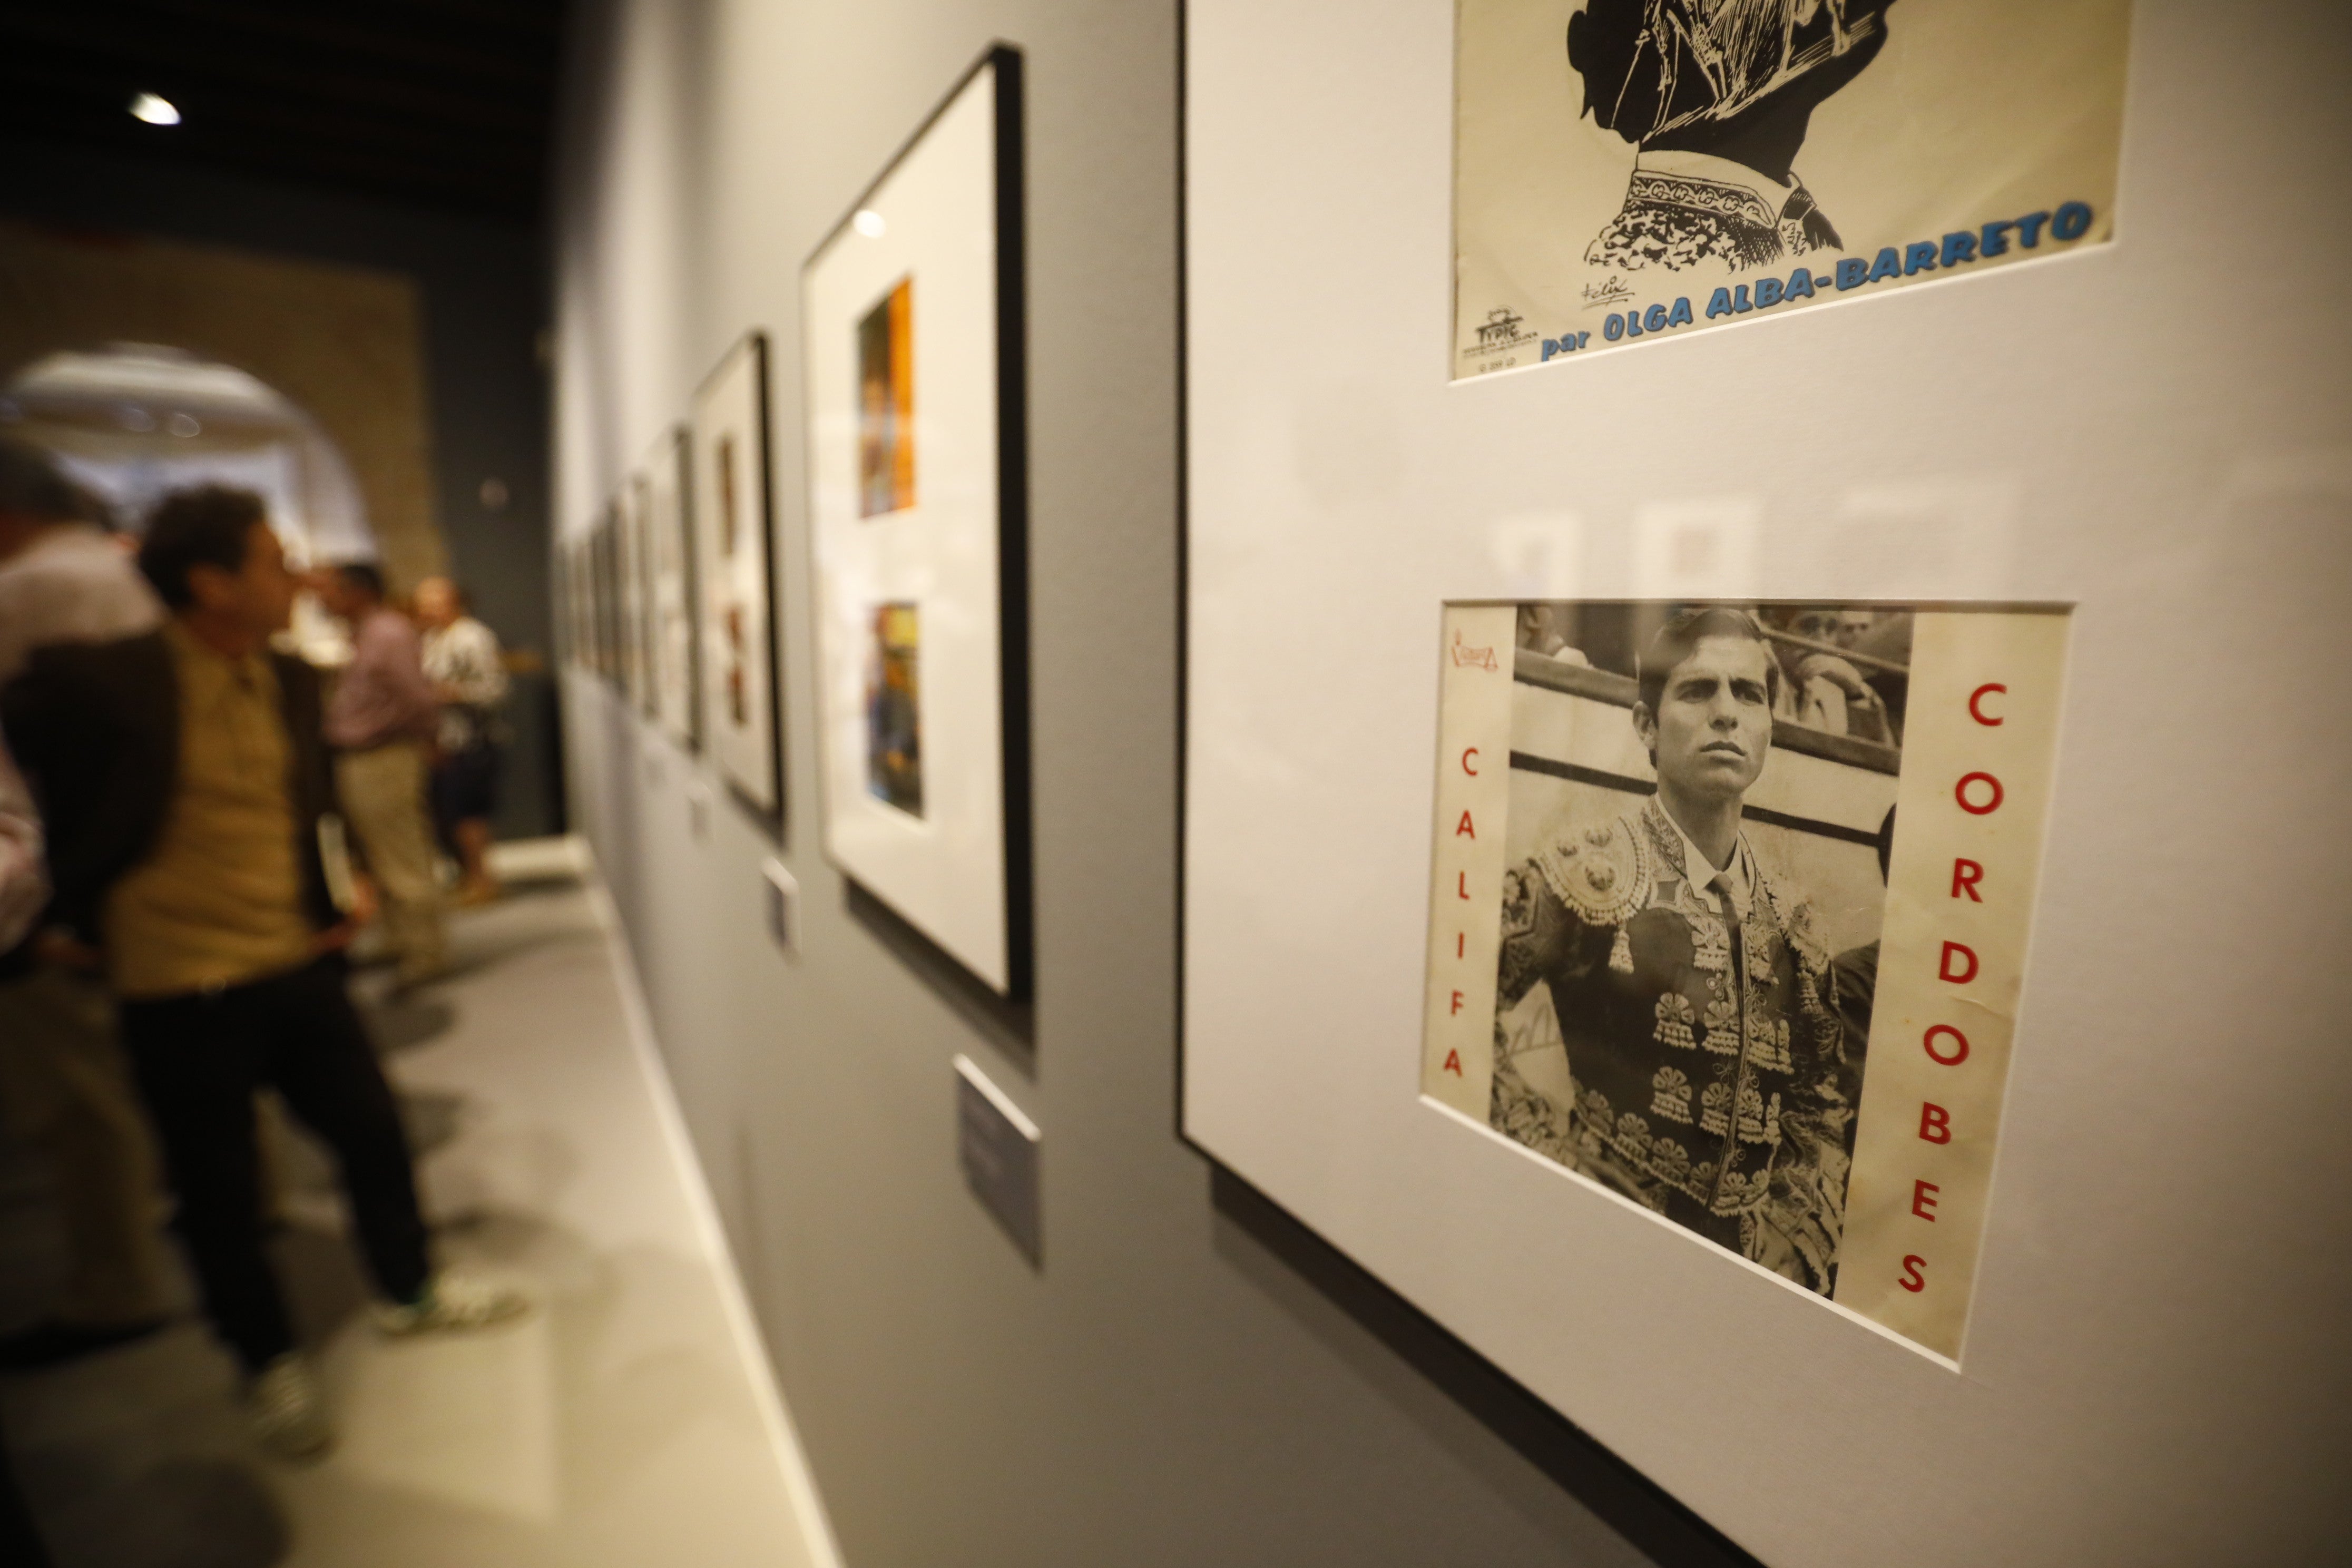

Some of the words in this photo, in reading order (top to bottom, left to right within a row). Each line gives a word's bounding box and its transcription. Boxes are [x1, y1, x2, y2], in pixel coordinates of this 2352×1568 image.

[1541, 330, 1591, 362] par
[1603, 297, 1693, 341] OLGA
[1704, 202, 2091, 319] ALBA-BARRETO
[1444, 747, 1479, 1077] CALIFA
[1898, 682, 2007, 1294] CORDOBES
